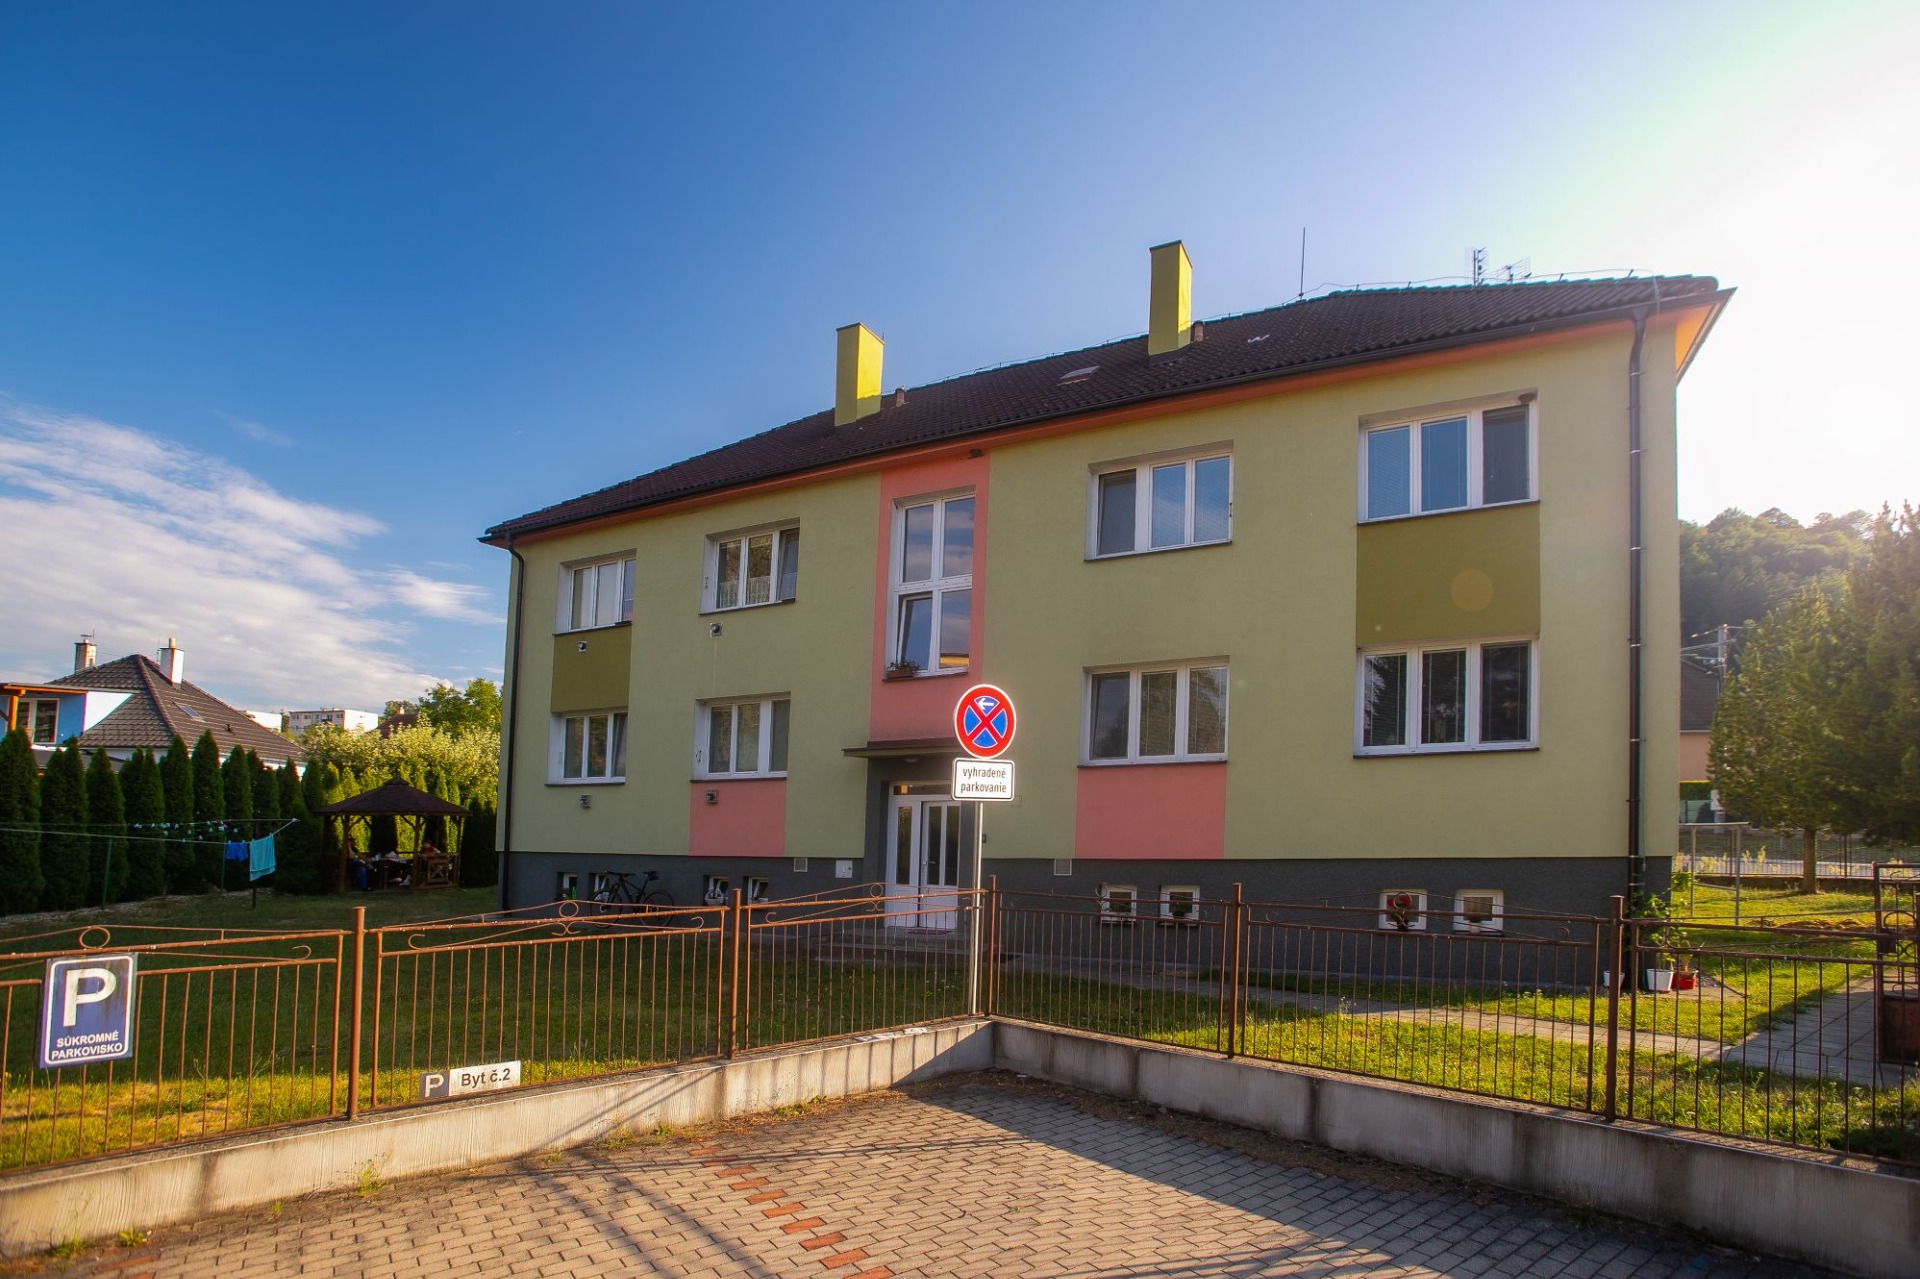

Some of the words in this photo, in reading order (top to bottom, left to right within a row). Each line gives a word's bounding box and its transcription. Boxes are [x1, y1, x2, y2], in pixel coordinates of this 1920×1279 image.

[963, 766, 1006, 780] vyhradené
[961, 782, 1007, 794] parkovanie
[63, 968, 117, 1027] P
[56, 1029, 119, 1048] SÚKROMNÉ
[51, 1042, 123, 1060] PARKOVISKO
[425, 1074, 444, 1098] P
[461, 1072, 486, 1088] Byt
[490, 1068, 511, 1082] č.2
